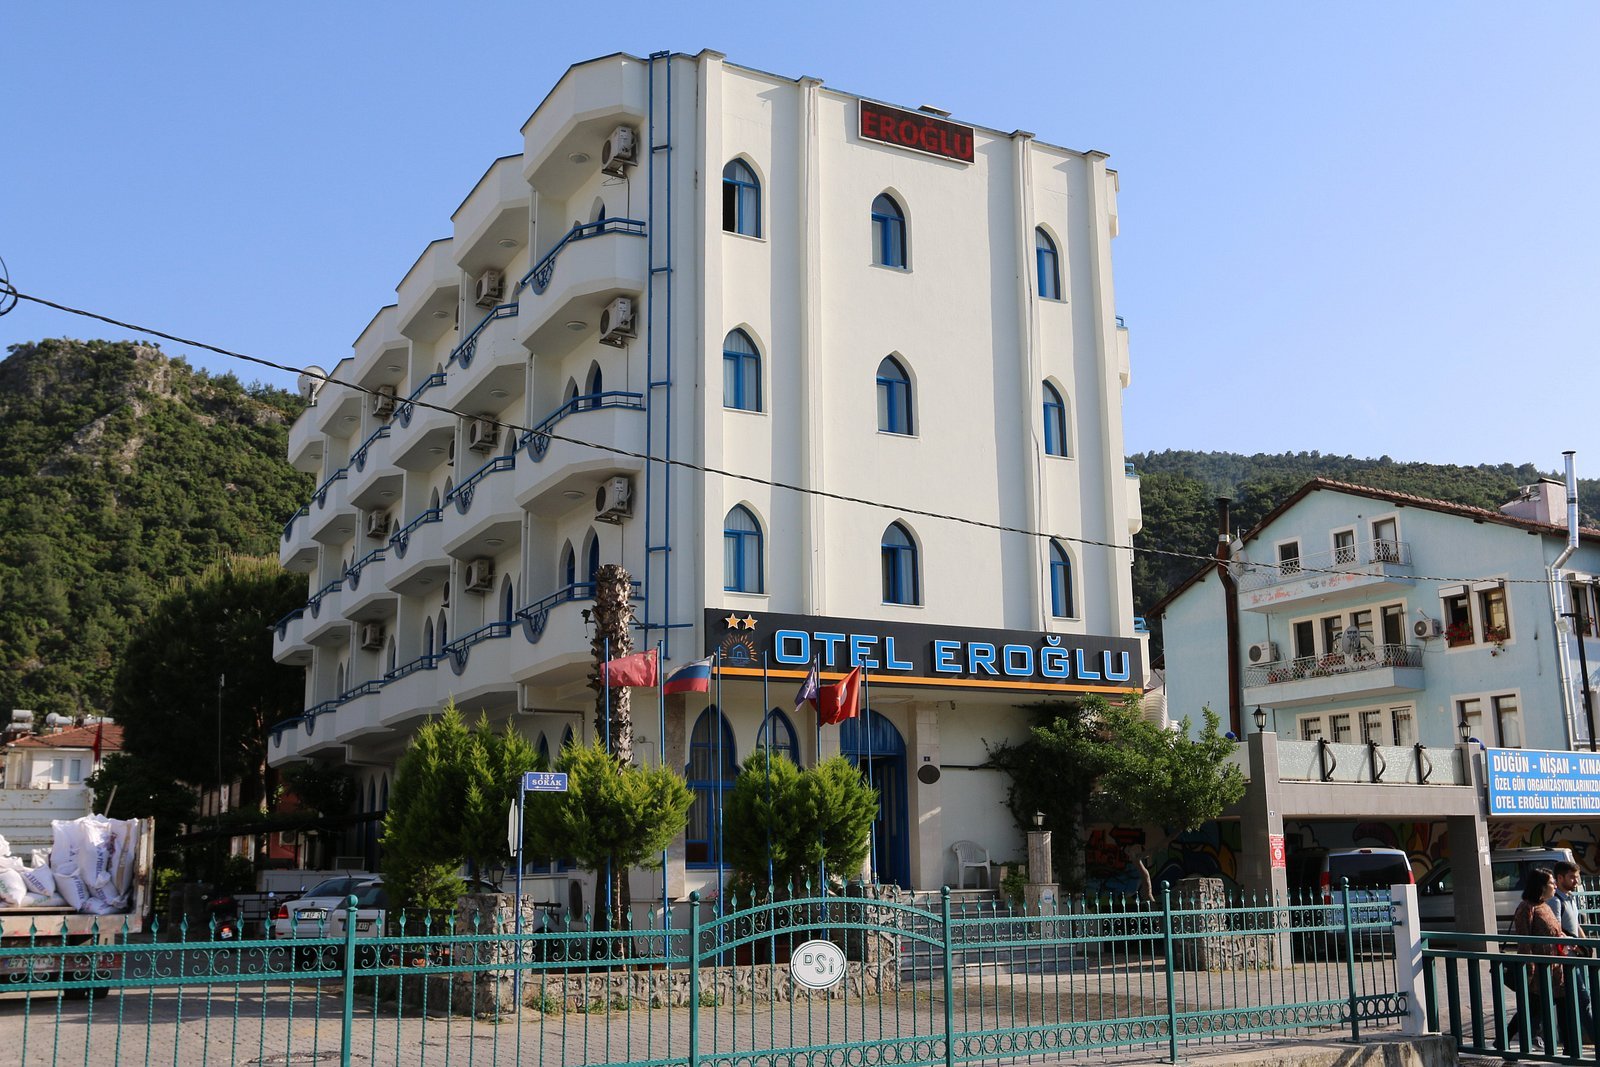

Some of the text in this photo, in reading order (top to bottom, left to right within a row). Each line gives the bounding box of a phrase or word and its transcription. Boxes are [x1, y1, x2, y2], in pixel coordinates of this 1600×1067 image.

[862, 111, 973, 159] EROĞLU
[775, 629, 1131, 682] OTEL EROĞLU
[1493, 752, 1530, 773] DÜĞÜN
[1539, 753, 1570, 778] NİŞAN
[1494, 774, 1512, 791] ÖZEL
[1512, 775, 1526, 791] GÜN
[1495, 795, 1517, 809] OTEL
[1518, 793, 1549, 810] EROĞLU
